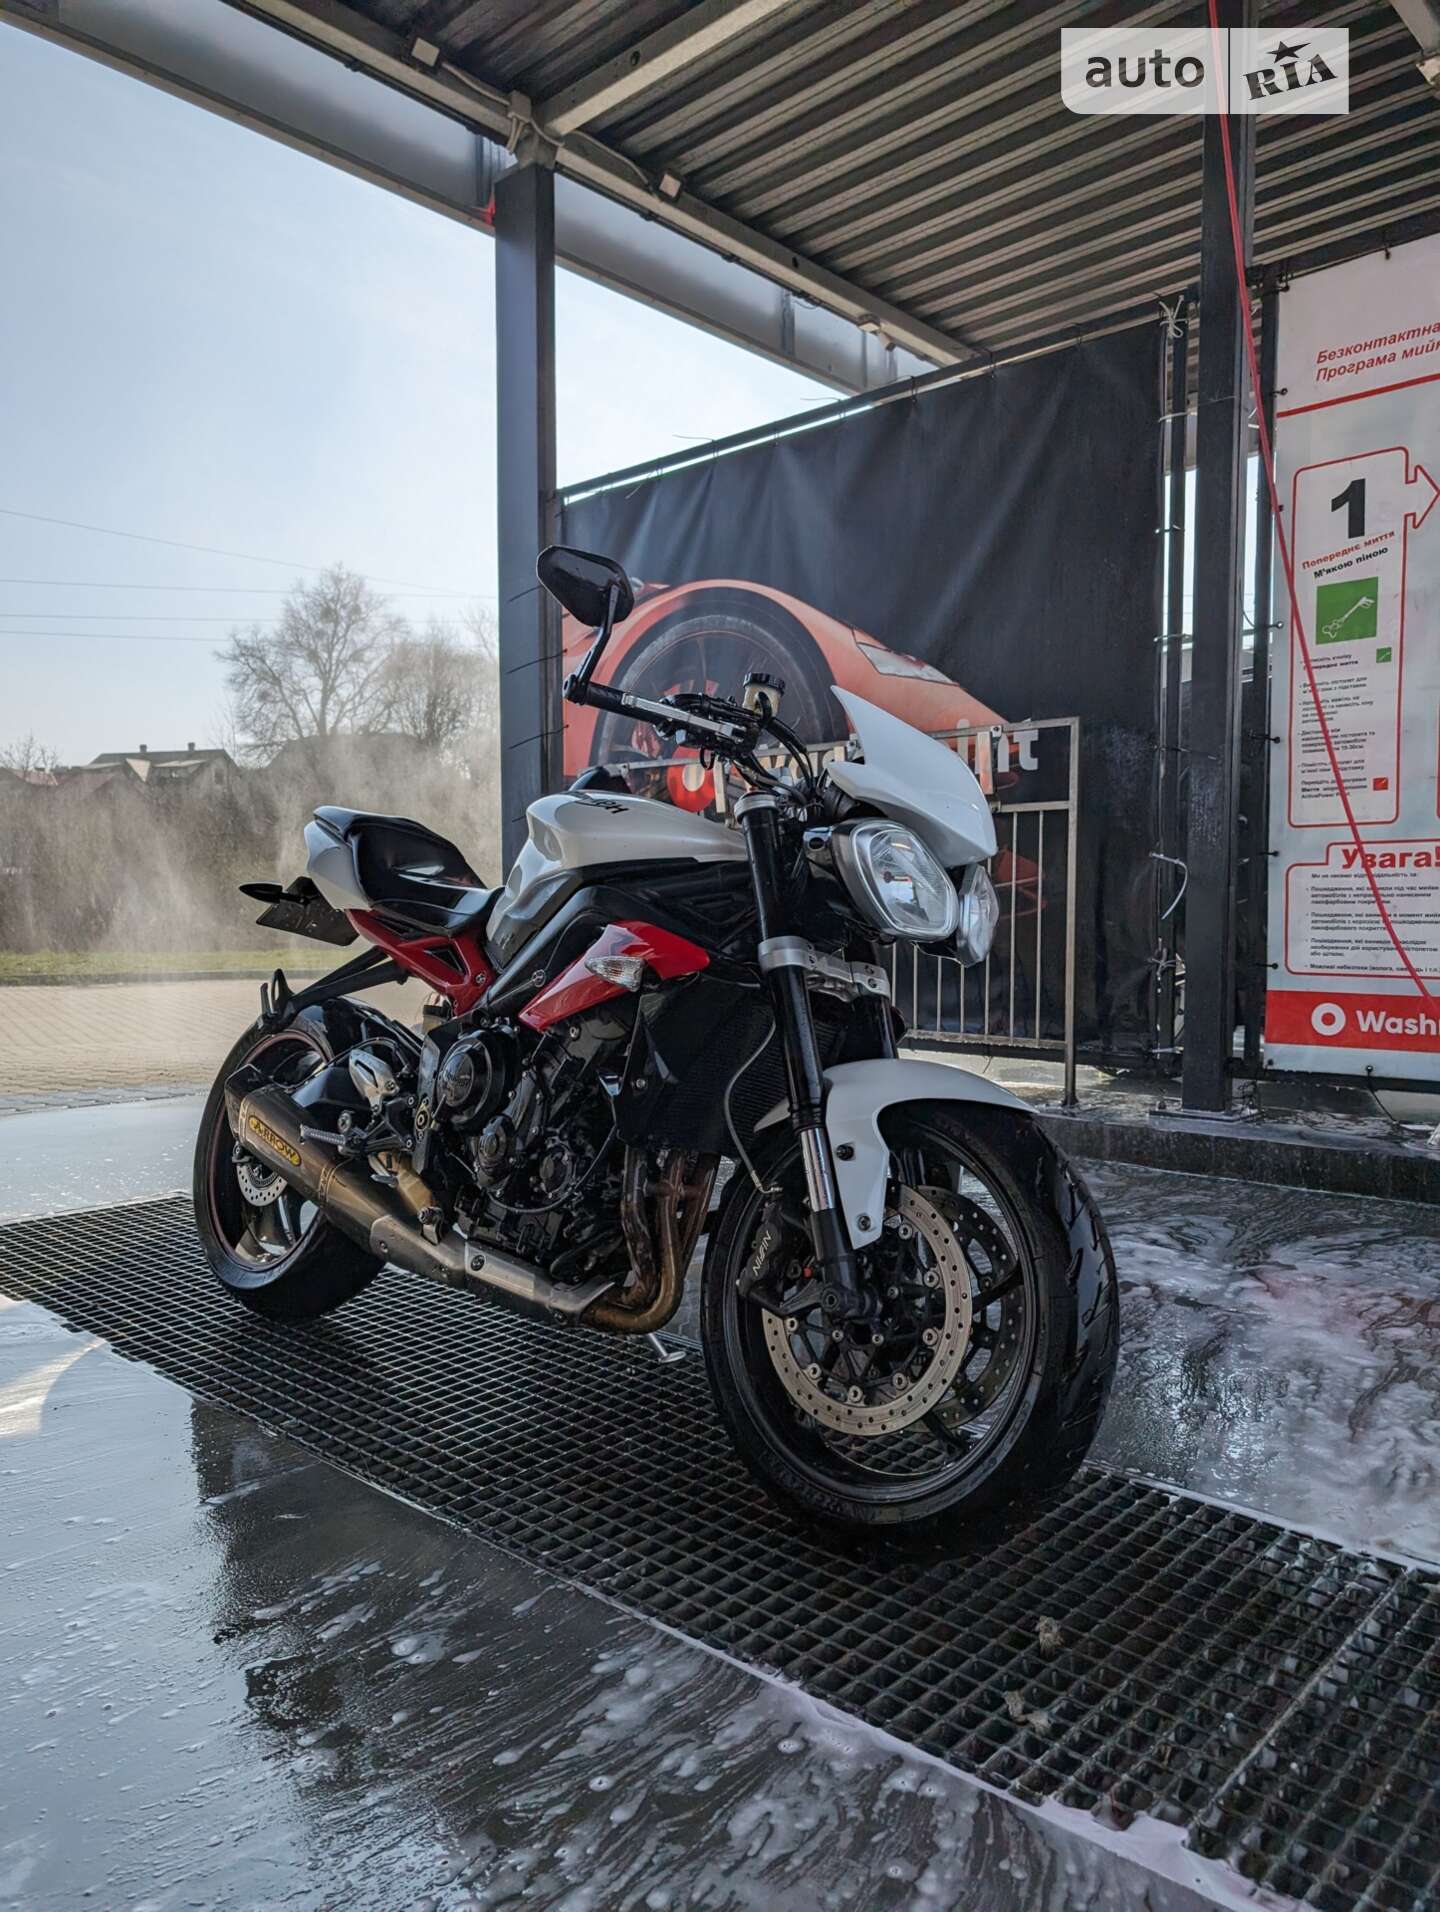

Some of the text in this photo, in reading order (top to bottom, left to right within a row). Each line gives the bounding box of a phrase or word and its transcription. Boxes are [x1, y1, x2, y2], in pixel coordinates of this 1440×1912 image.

[1316, 352, 1397, 382] Програма
[1331, 478, 1366, 539] 1
[1363, 530, 1396, 548] миття
[1355, 547, 1389, 565] піною
[1355, 1009, 1440, 1036] Wash
